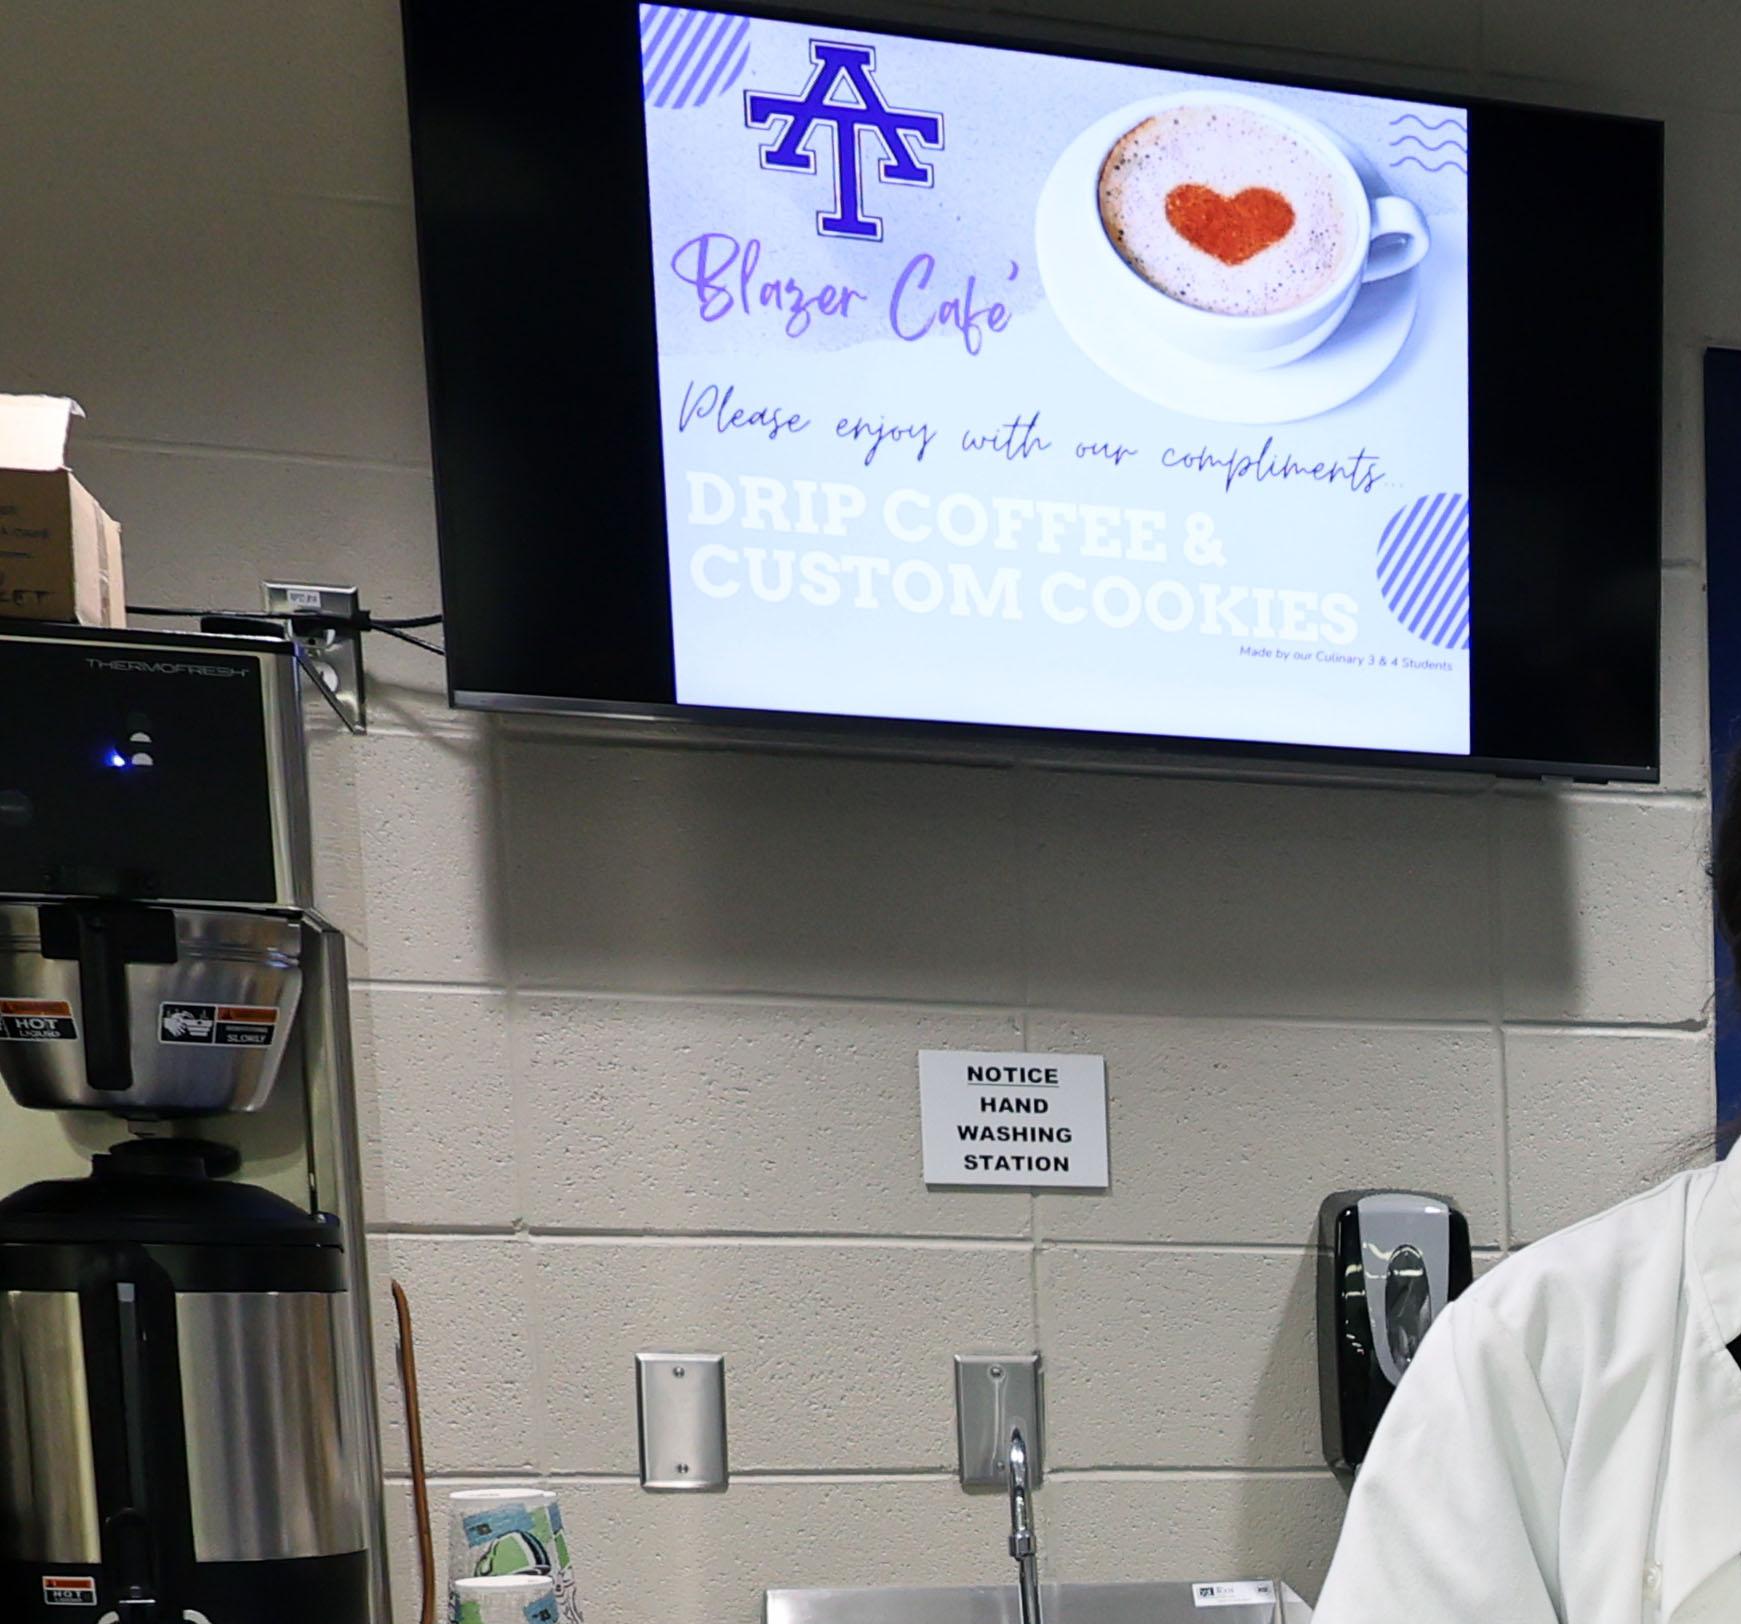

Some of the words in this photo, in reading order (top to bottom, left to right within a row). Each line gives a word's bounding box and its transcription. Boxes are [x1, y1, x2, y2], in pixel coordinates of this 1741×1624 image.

[671, 233, 867, 338] Blazer
[679, 381, 811, 440] Please
[836, 414, 937, 467] enjoy
[962, 411, 1052, 460] with
[1075, 440, 1138, 466] our
[685, 470, 867, 537] DRIP
[882, 488, 1168, 563] COFFEE
[1183, 511, 1228, 568] &
[689, 544, 1023, 621] CUSTOM
[1040, 571, 1360, 646] COOKIES
[1239, 645, 1272, 659] Made
[1275, 647, 1290, 662] by
[1293, 651, 1313, 661] our
[1315, 650, 1364, 667] Culinary
[1402, 657, 1454, 672] Students
[15, 1018, 58, 1030] HOT
[967, 1065, 1059, 1085] NOTICE
[980, 1096, 1049, 1114] HAND
[957, 1125, 1073, 1143] WASHING
[963, 1154, 1070, 1172] STATION
